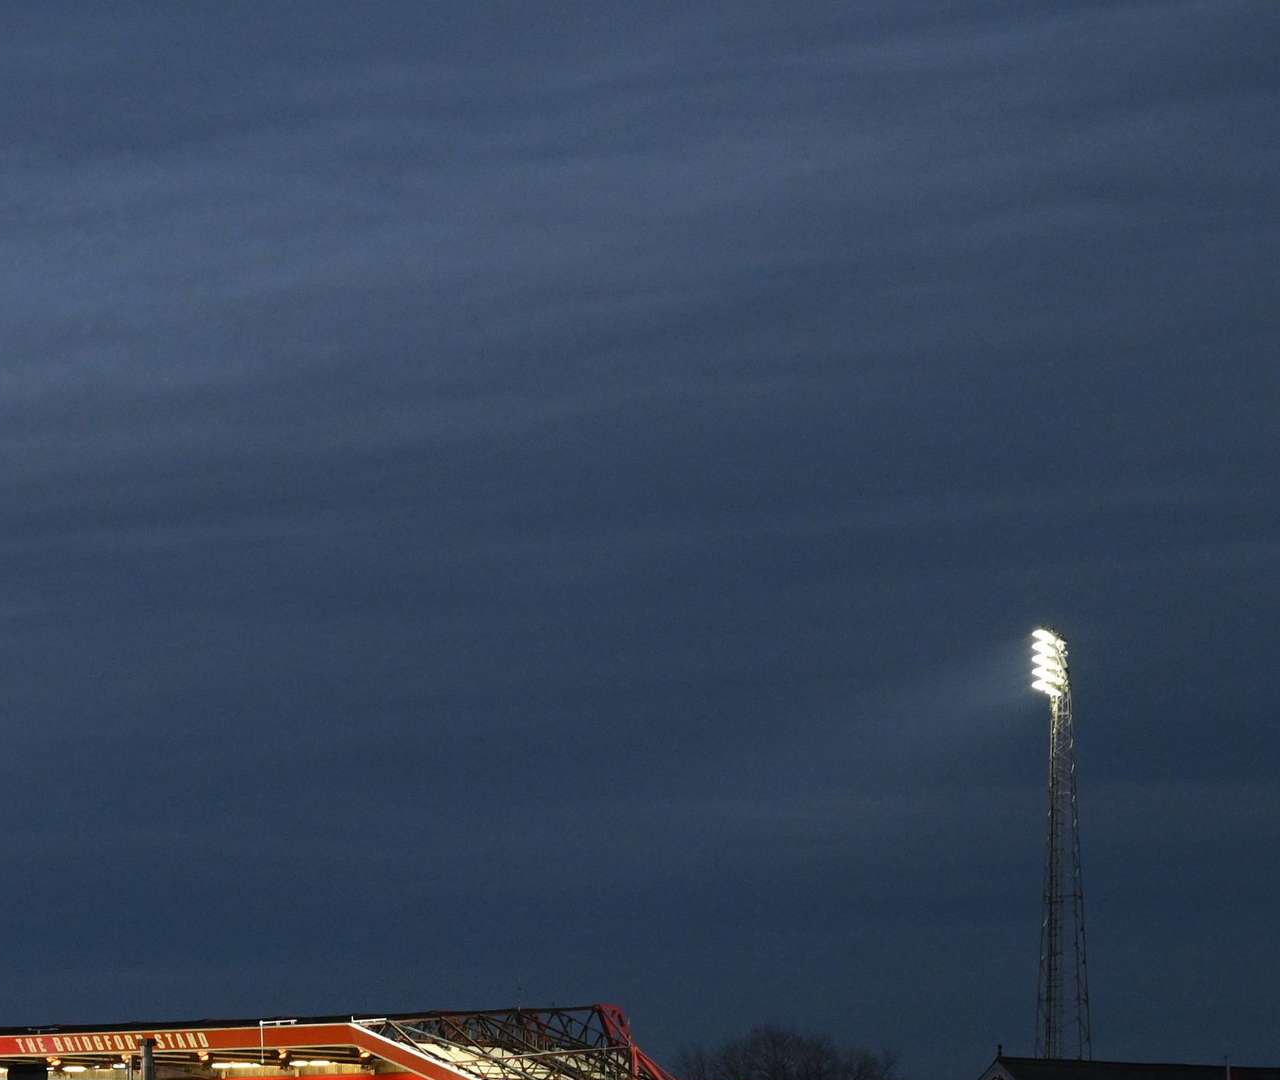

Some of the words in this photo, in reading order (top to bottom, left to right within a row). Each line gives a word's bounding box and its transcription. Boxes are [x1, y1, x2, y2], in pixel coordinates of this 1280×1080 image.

[15, 1037, 46, 1053] THE
[53, 1034, 144, 1052] BRIDGFOR
[154, 1031, 209, 1049] STAND
